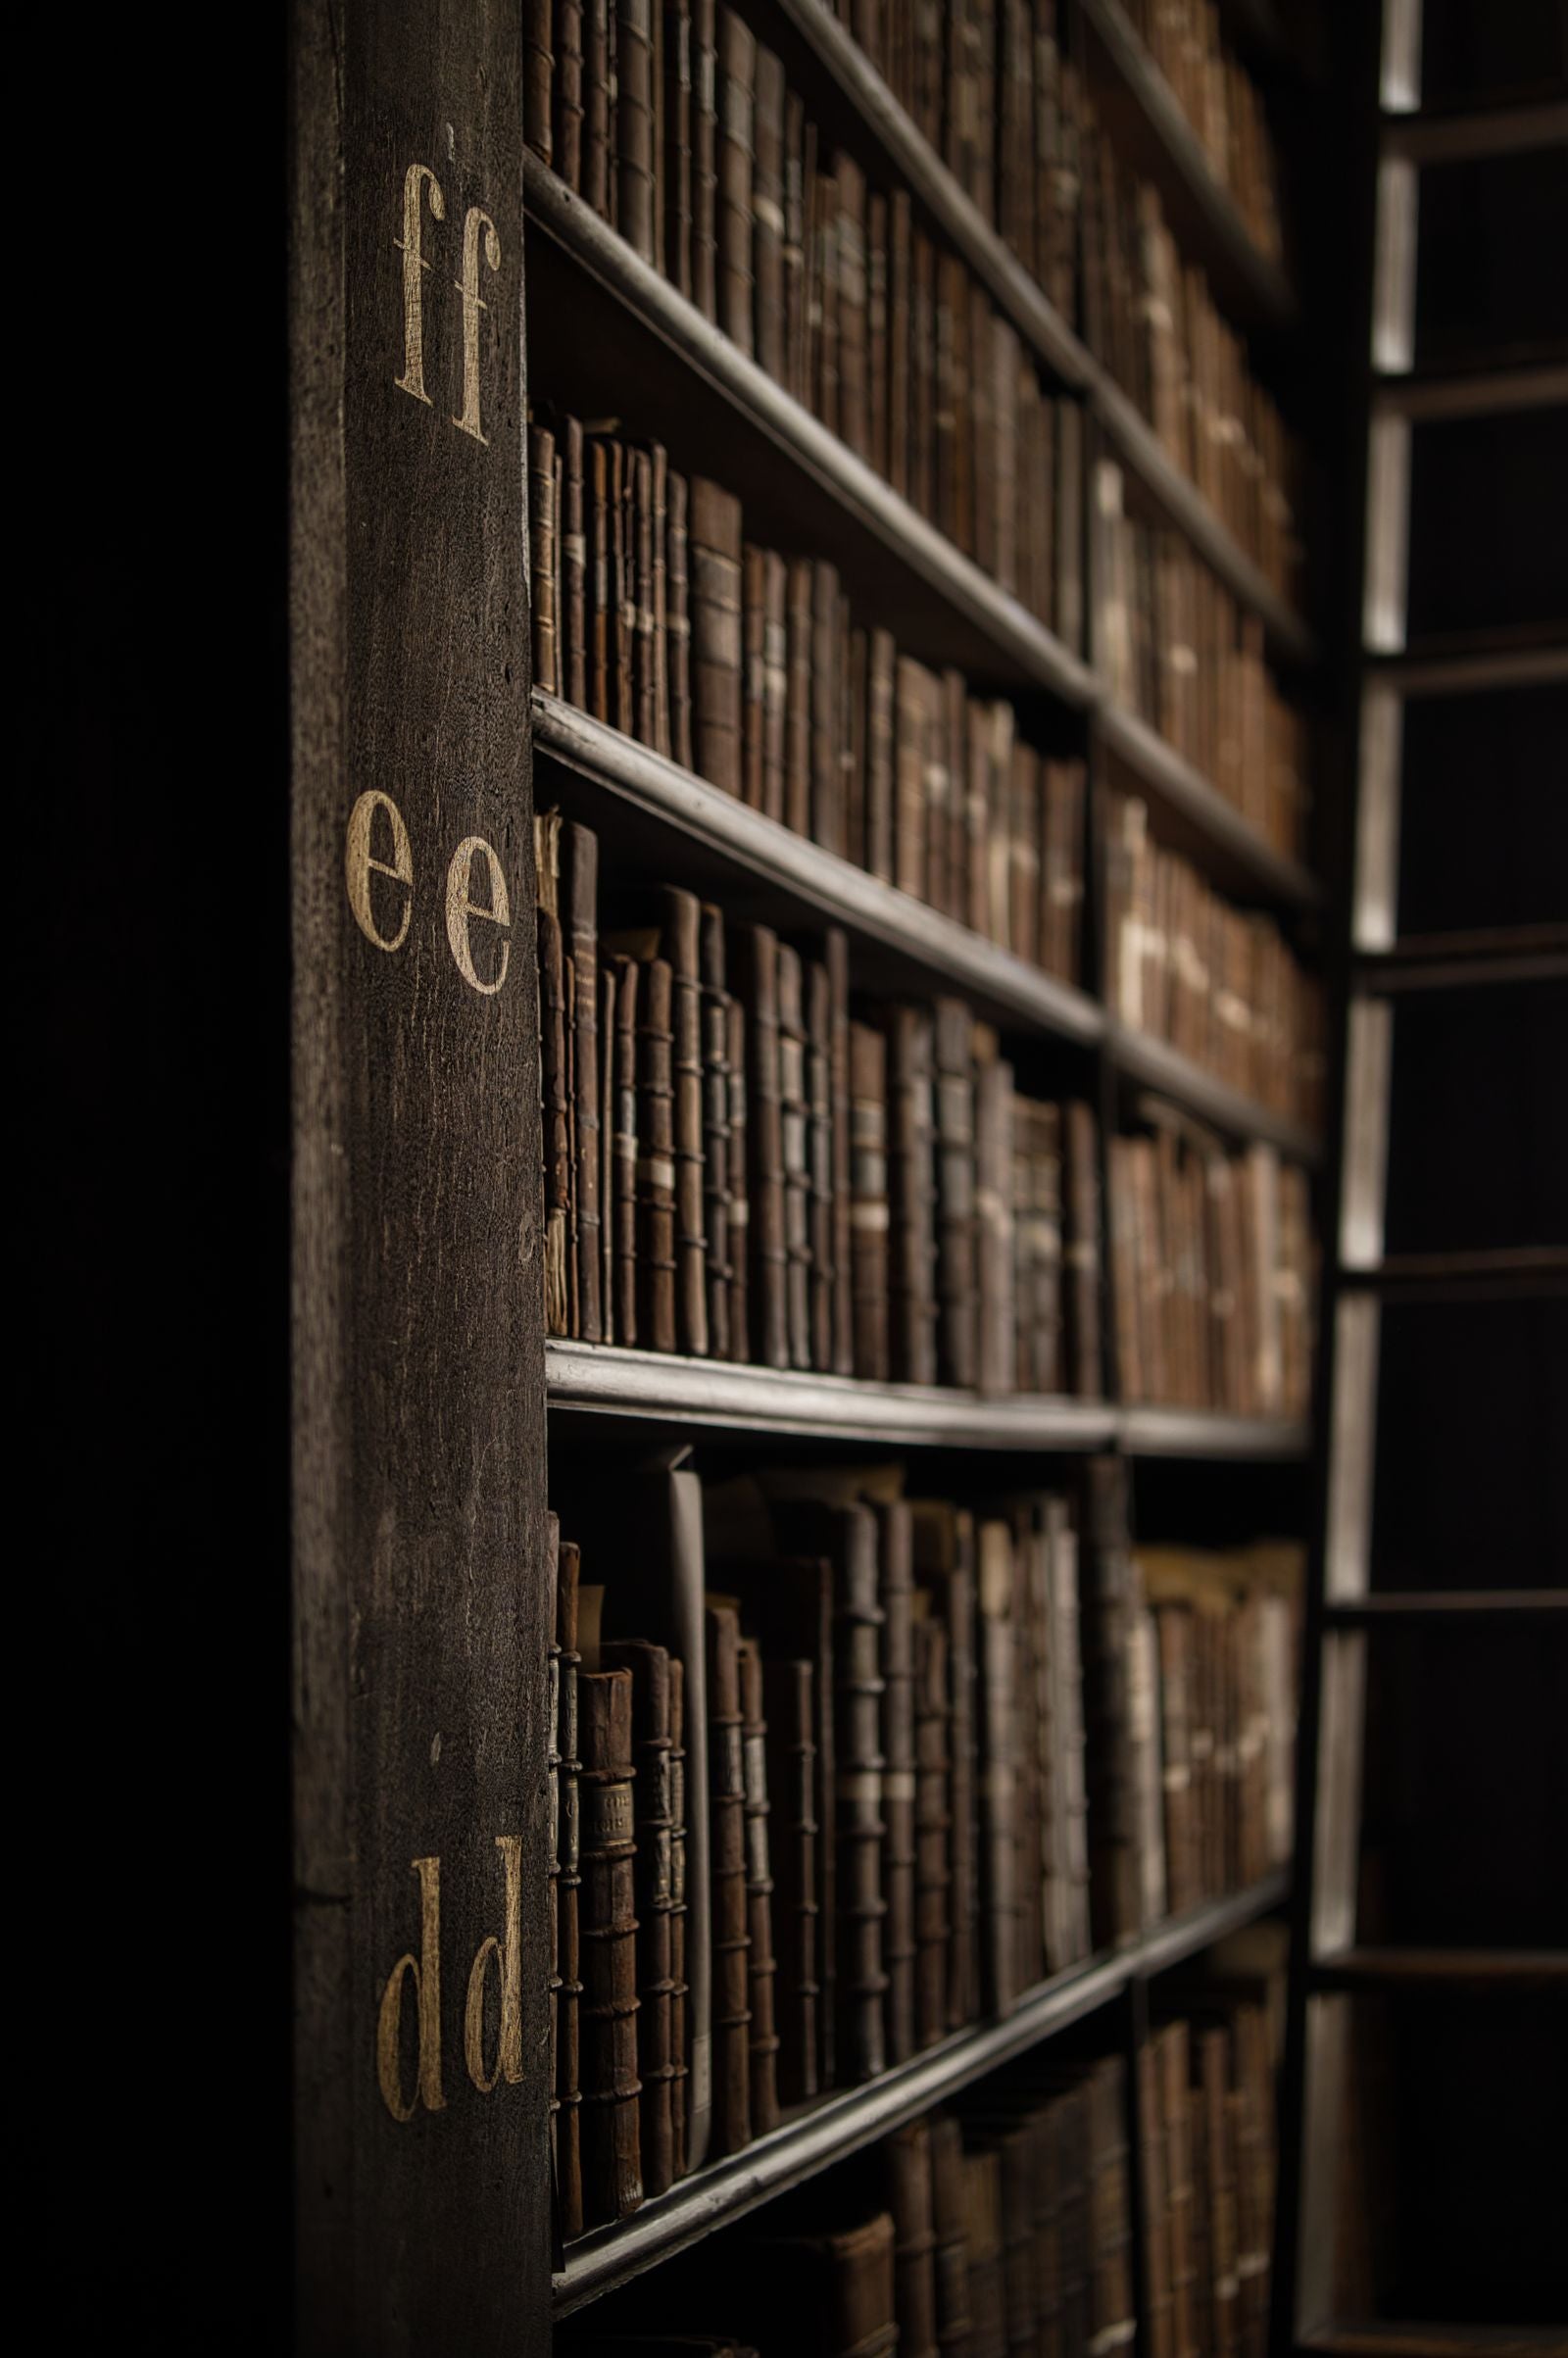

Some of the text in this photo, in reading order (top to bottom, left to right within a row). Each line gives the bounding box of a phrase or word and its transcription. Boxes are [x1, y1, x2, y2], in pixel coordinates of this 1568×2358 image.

[393, 164, 501, 446] ff
[346, 790, 511, 995] ee
[377, 1835, 524, 2122] dd
